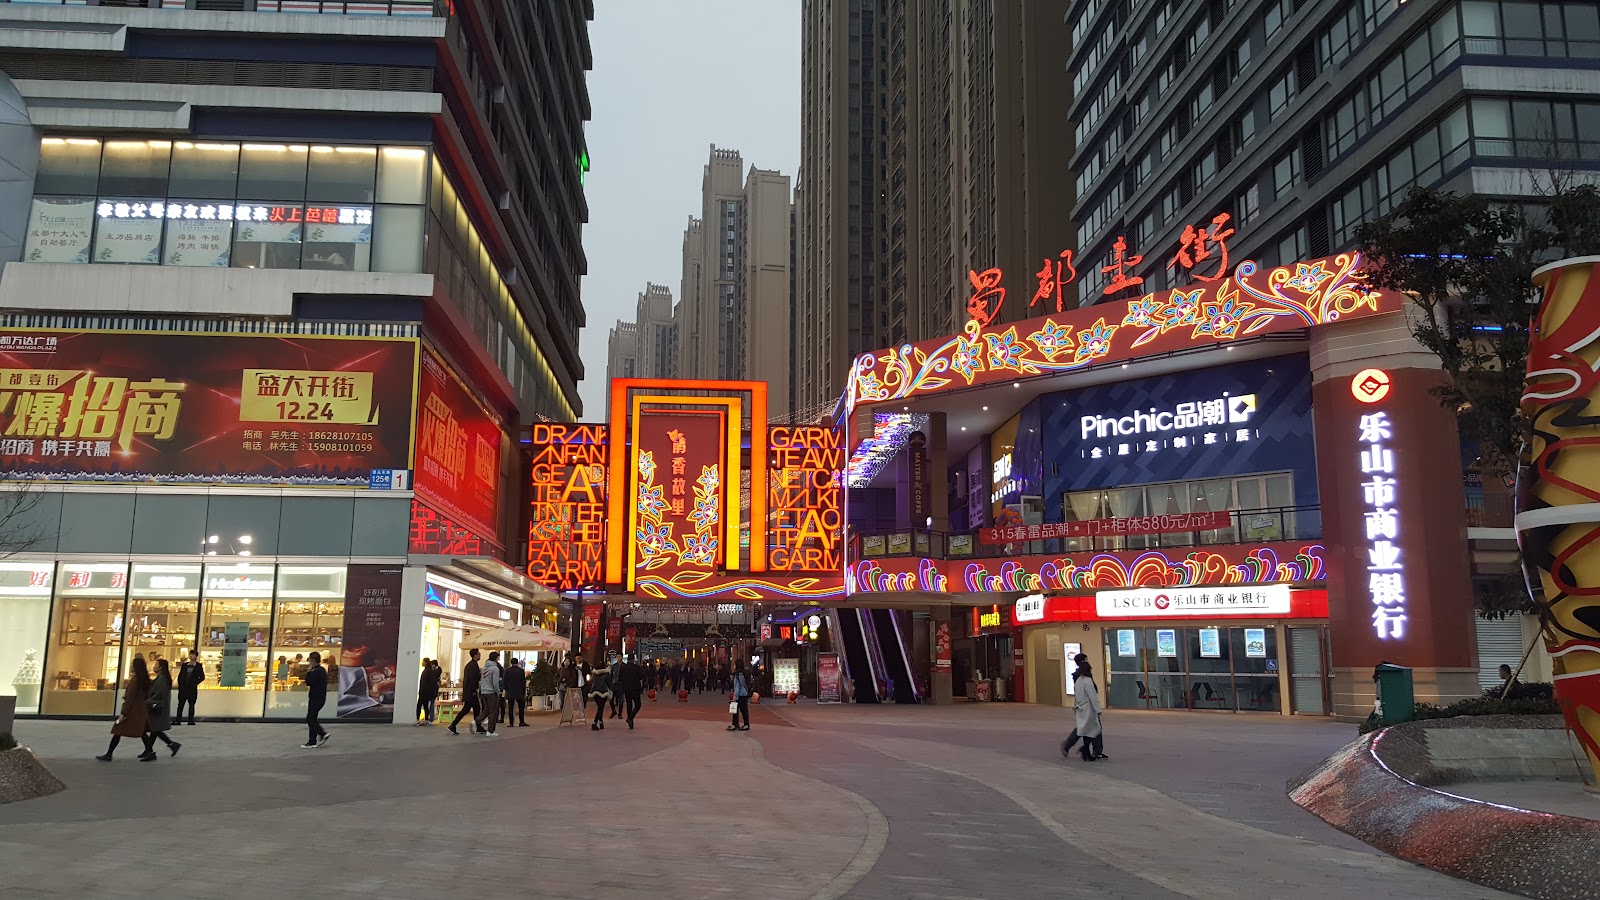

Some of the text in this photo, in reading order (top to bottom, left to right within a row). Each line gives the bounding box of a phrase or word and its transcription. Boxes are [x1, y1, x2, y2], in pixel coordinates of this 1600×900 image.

[30, 230, 88, 238] 成都十大人气
[40, 239, 78, 247] 自助餐厅
[0, 373, 59, 386] 都壹街
[257, 375, 354, 398] 盛大开街
[276, 401, 334, 421] 12.24
[243, 430, 263, 440] 招商
[41, 440, 111, 457] 携手共赢
[242, 441, 262, 451] 电话
[914, 452, 922, 481] MASTER
[1358, 410, 1407, 639] 乐山市商业银行
[364, 588, 387, 597] 好利来
[359, 597, 392, 605] 现烤面包
[1113, 592, 1267, 609] LSCB 乐山市商业银行
